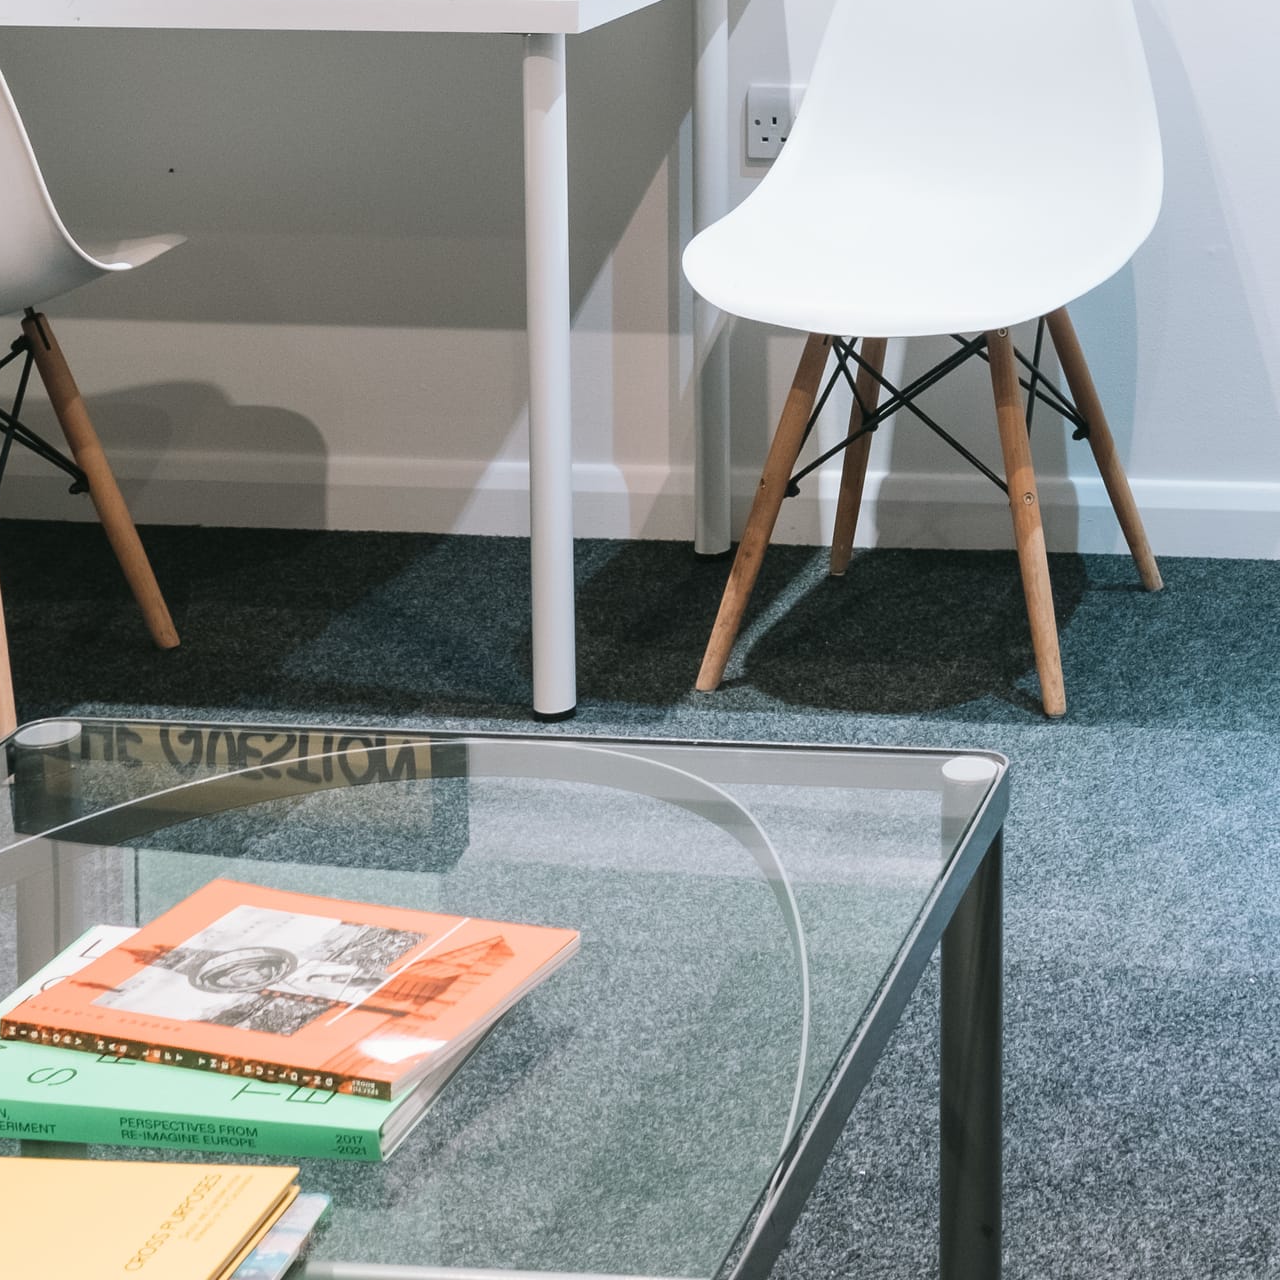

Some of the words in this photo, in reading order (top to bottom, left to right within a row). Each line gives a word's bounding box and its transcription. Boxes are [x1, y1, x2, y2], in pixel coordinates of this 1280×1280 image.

[8, 1026, 83, 1046] HISTORY
[97, 1040, 128, 1053] HAS
[142, 1049, 183, 1062] LEFT
[198, 1057, 229, 1070] THE
[244, 1064, 333, 1087] BUILDING
[119, 1116, 216, 1134] PERSPECTIVES
[219, 1124, 258, 1137] FROM
[121, 1129, 200, 1145] RE-IMAGINE
[203, 1133, 256, 1148] EUROPE
[335, 1134, 363, 1145] 2017
[124, 1232, 171, 1271] CROSS
[159, 1174, 222, 1230] PURPOSES
